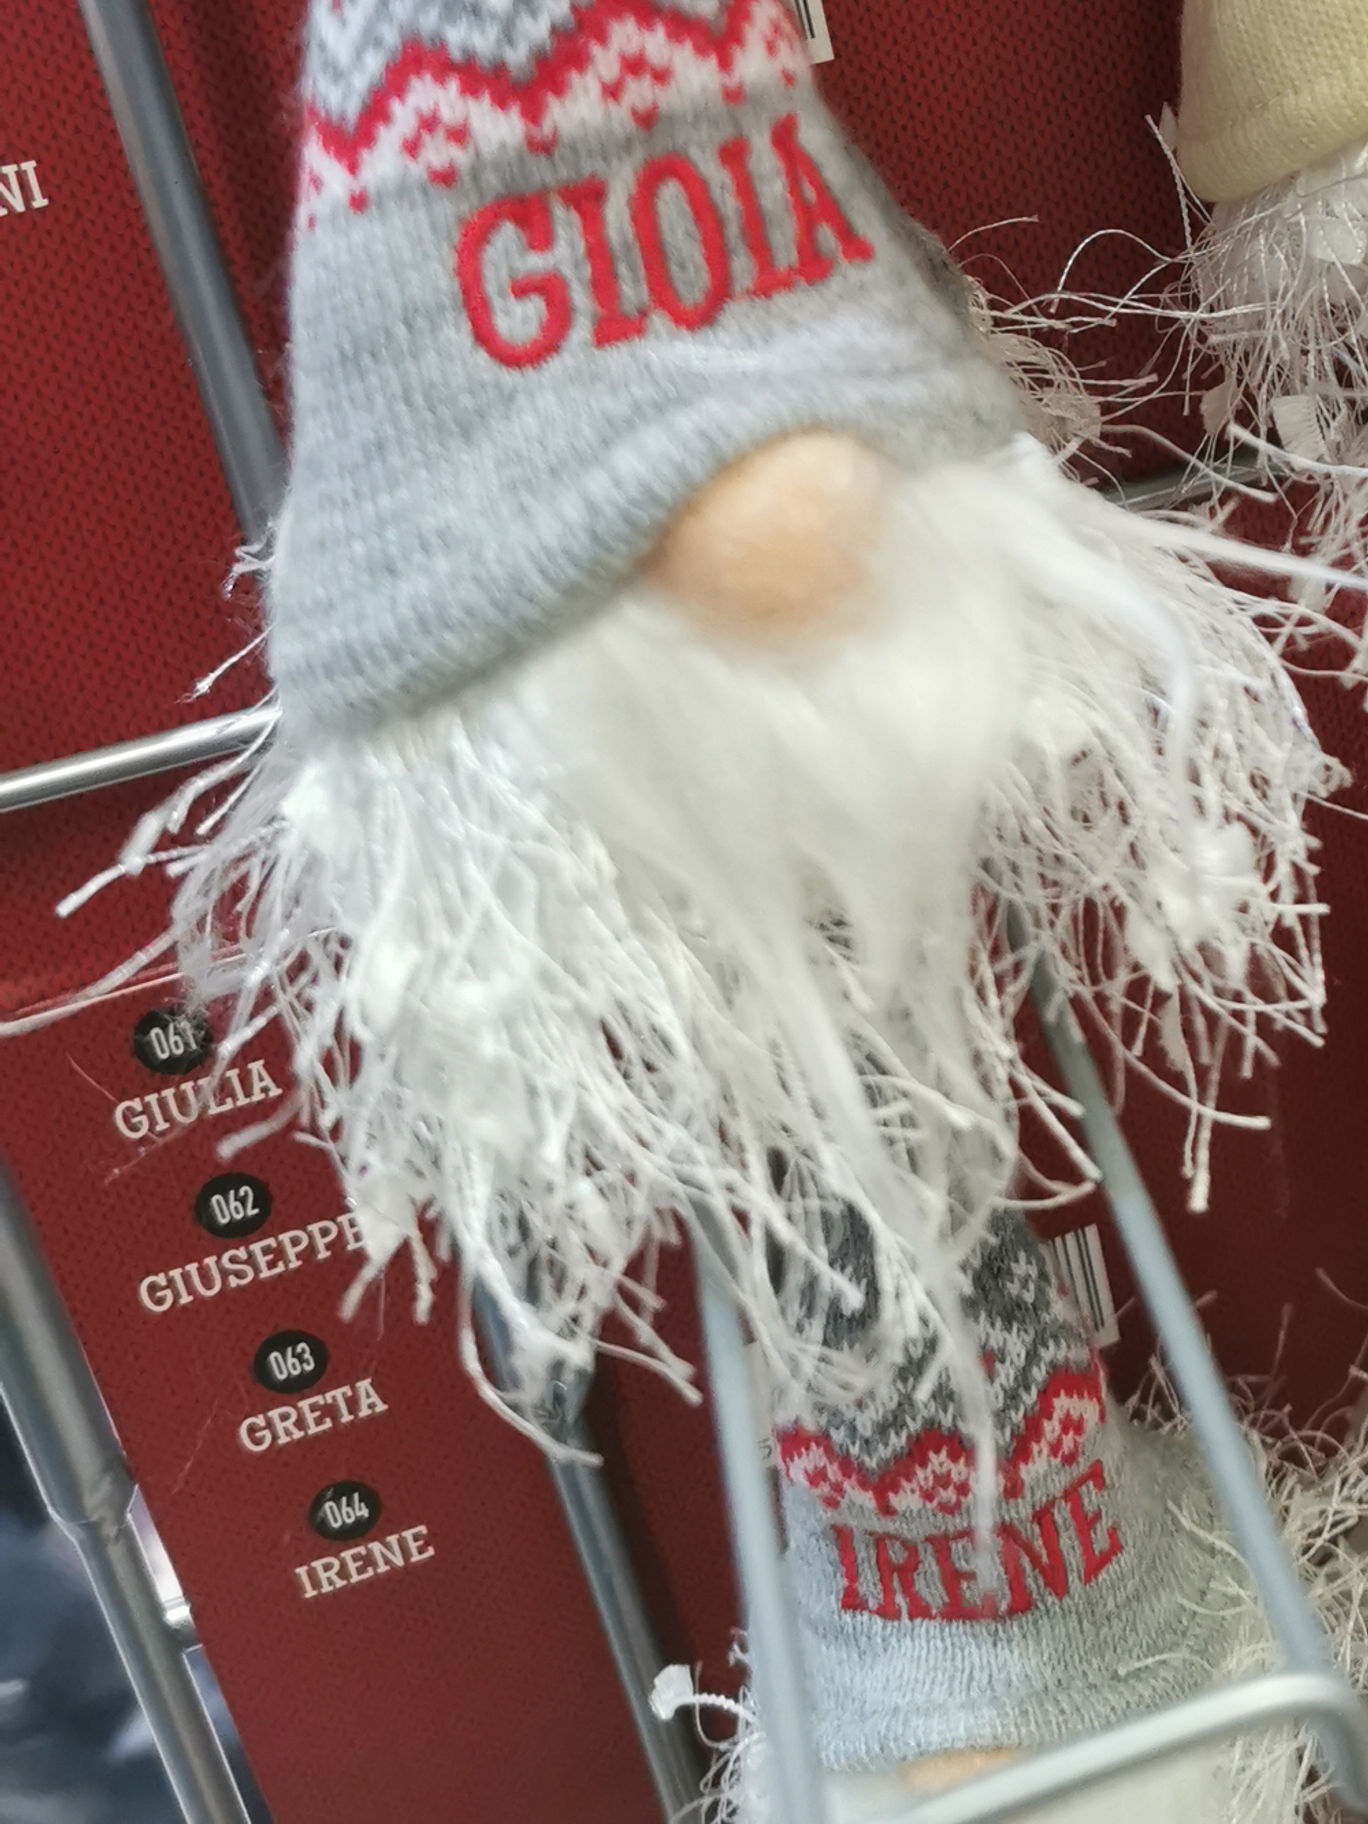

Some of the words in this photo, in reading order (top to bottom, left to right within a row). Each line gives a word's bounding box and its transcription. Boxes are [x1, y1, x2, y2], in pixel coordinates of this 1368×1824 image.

[455, 113, 875, 370] GIOIA
[150, 1019, 198, 1060] 061
[113, 1059, 283, 1140] GIULIA
[210, 1184, 260, 1226] 062
[139, 1212, 367, 1313] GIUSEPPE
[269, 1341, 316, 1382] 063
[239, 1377, 388, 1453] GRETA
[323, 1490, 370, 1530] 064
[829, 1458, 1125, 1623] IRENE
[294, 1524, 436, 1600] IRENE
